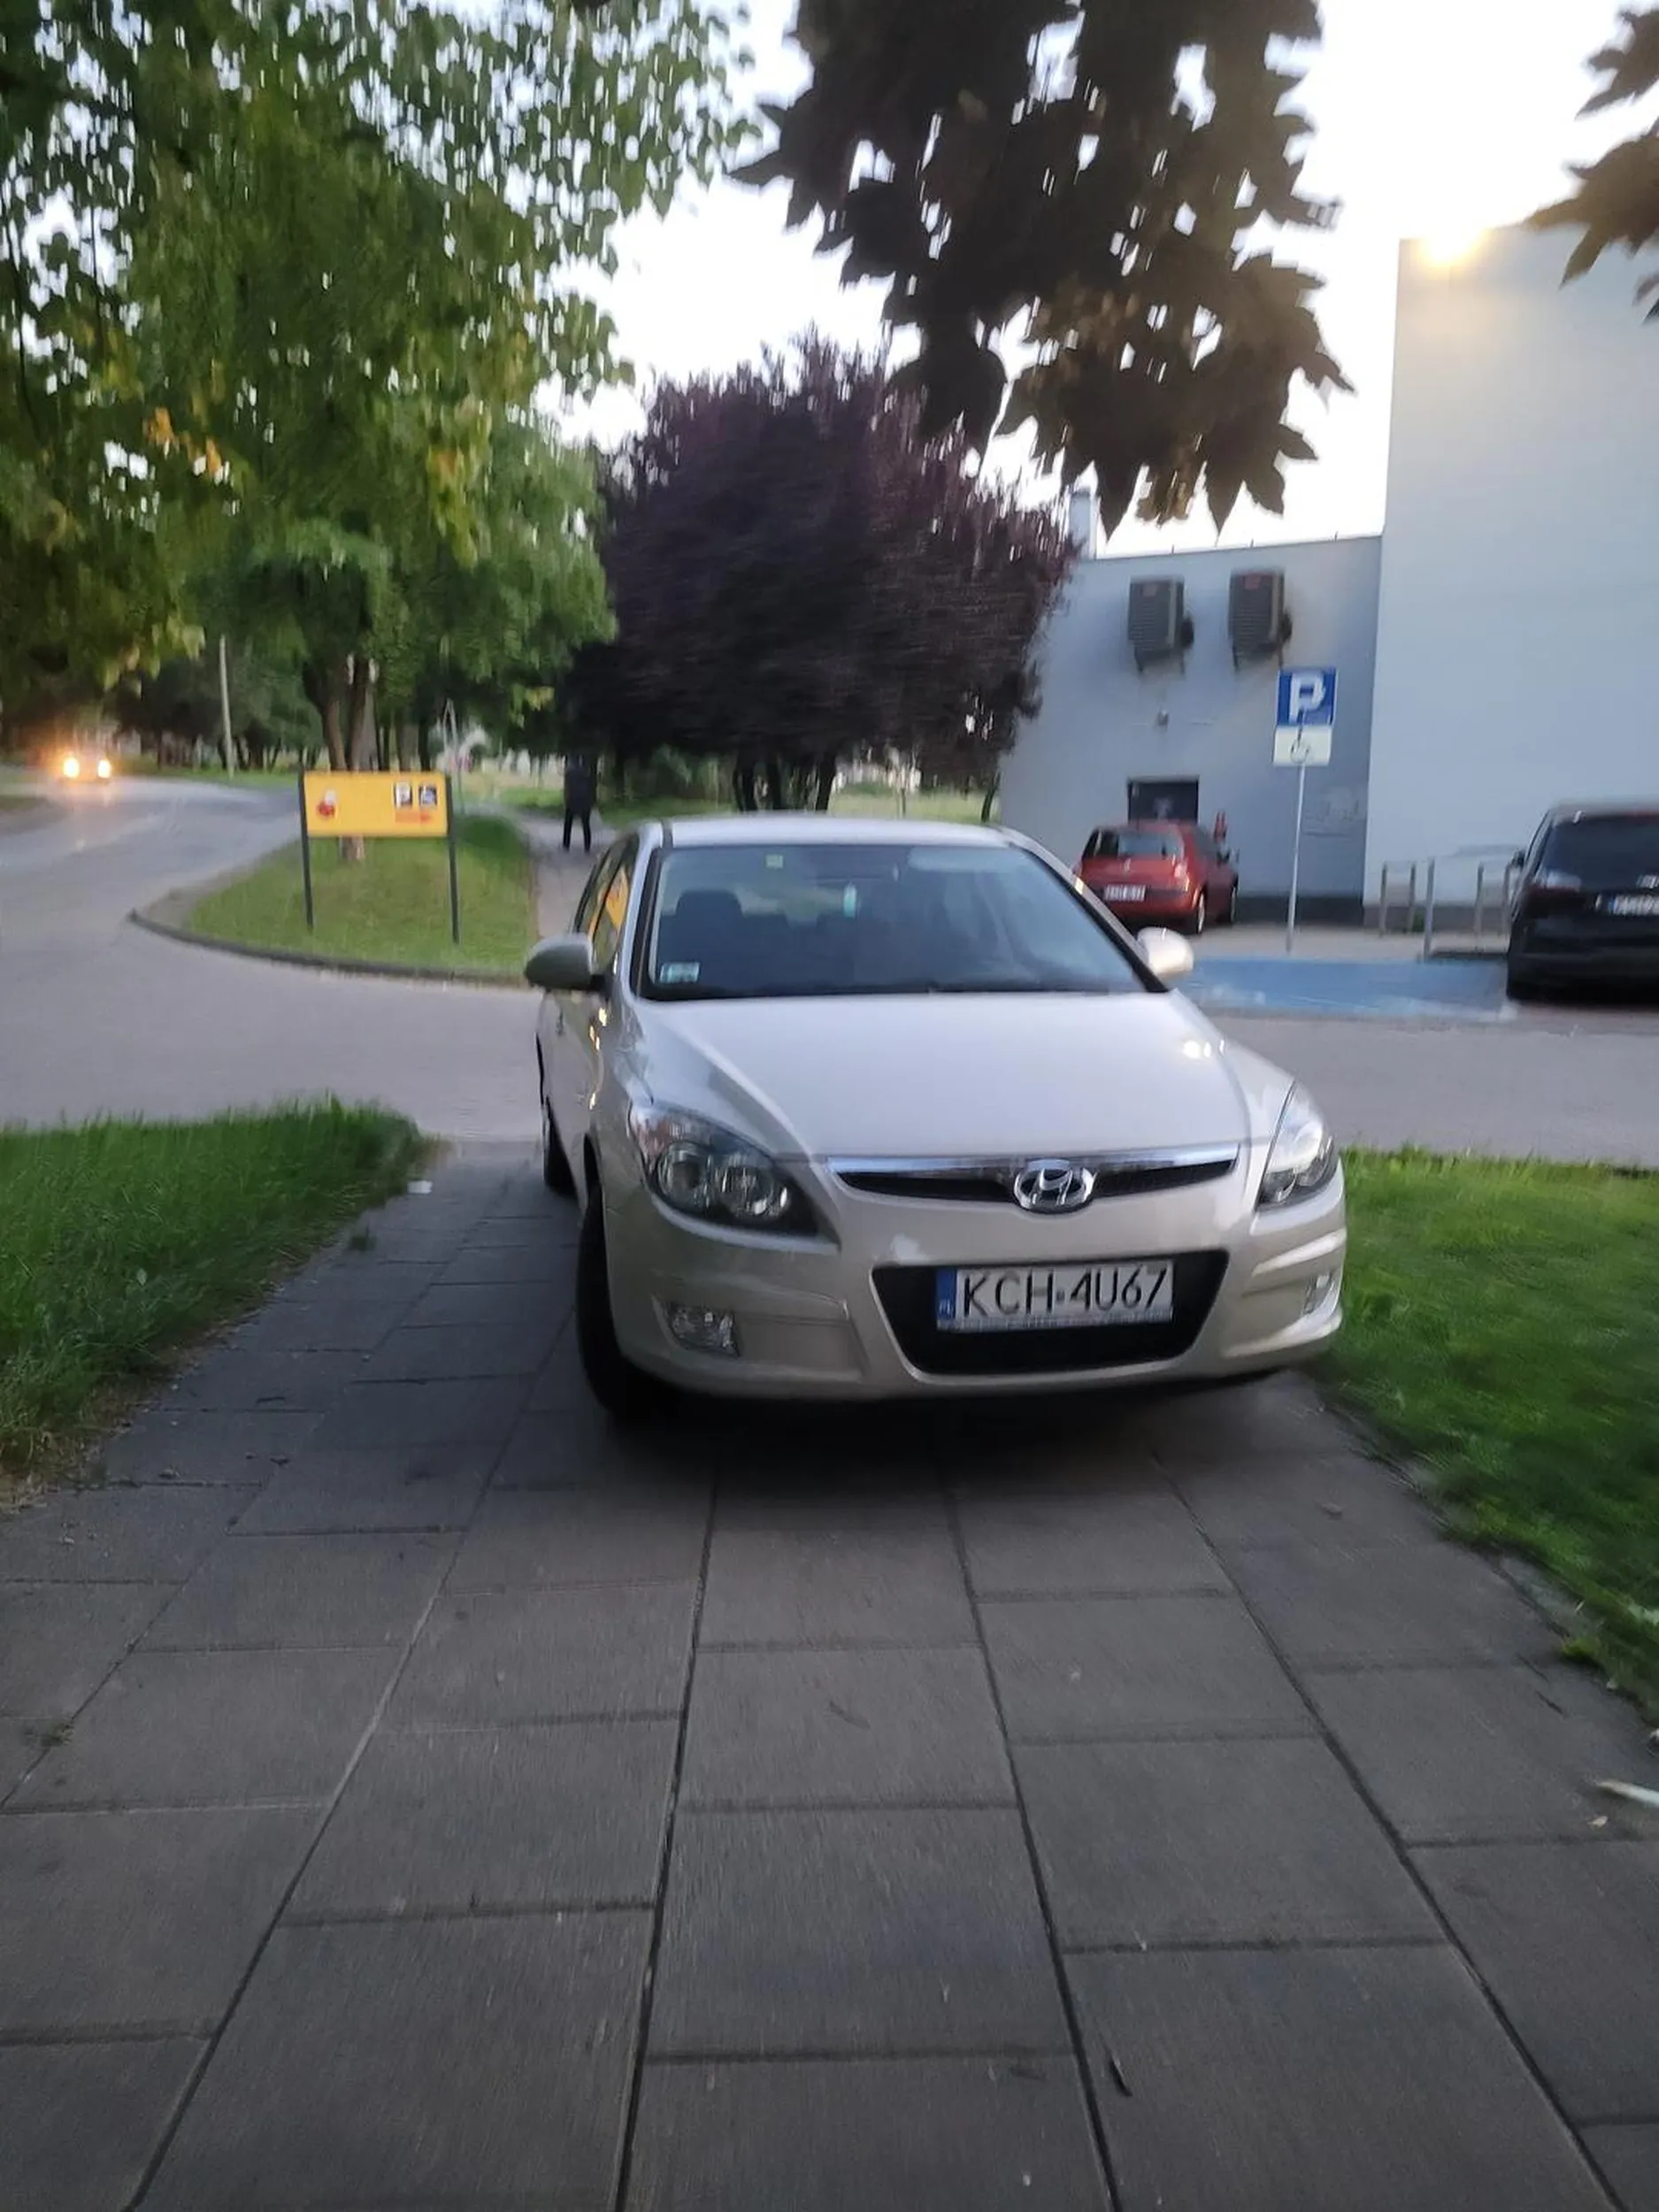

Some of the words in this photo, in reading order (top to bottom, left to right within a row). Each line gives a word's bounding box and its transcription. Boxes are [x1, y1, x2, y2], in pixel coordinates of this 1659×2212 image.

[1289, 673, 1325, 722] P
[964, 1270, 1054, 1317] KCH
[1070, 1264, 1168, 1311] 4U67
